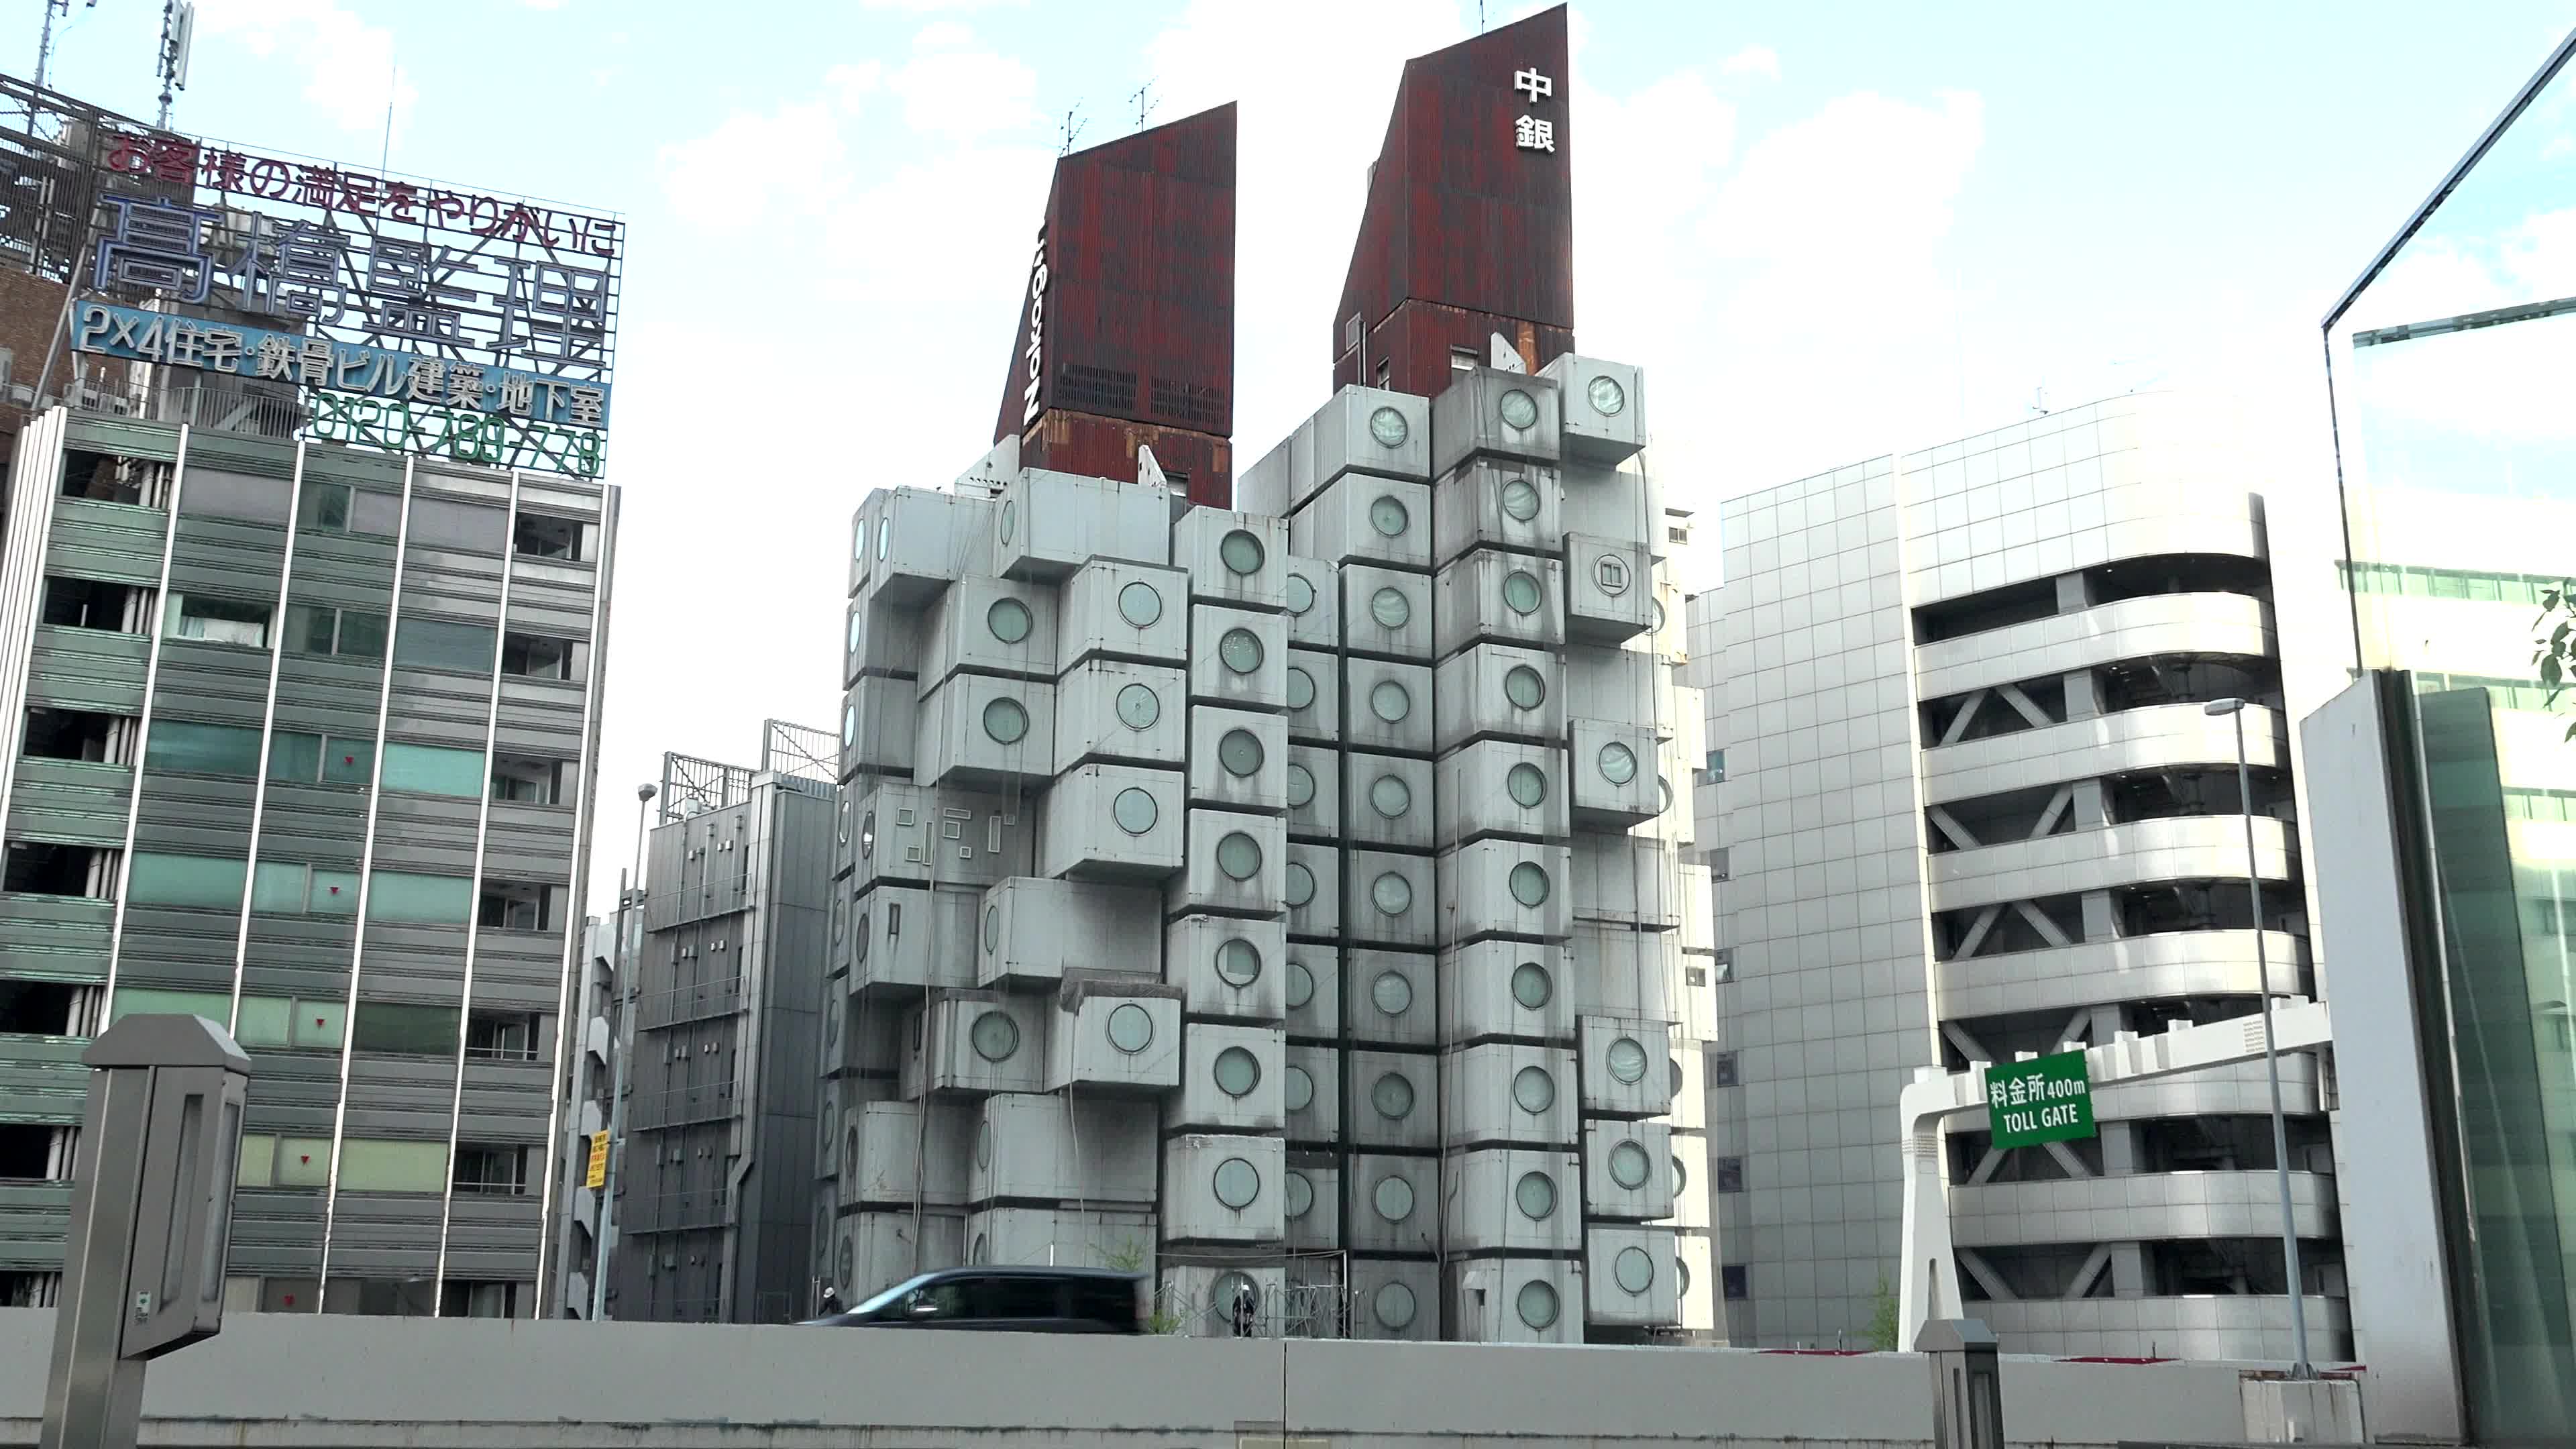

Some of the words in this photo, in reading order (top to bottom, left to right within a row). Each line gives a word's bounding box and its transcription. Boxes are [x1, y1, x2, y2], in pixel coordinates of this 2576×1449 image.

[1514, 67, 1555, 153] 中銀
[107, 135, 616, 256] お客様の満足をやりがいに
[1023, 227, 1048, 426] Nakagi
[313, 392, 600, 476] 0120-789-778
[2003, 1110, 2038, 1133] TOLL
[2041, 1104, 2079, 1128] GATE
